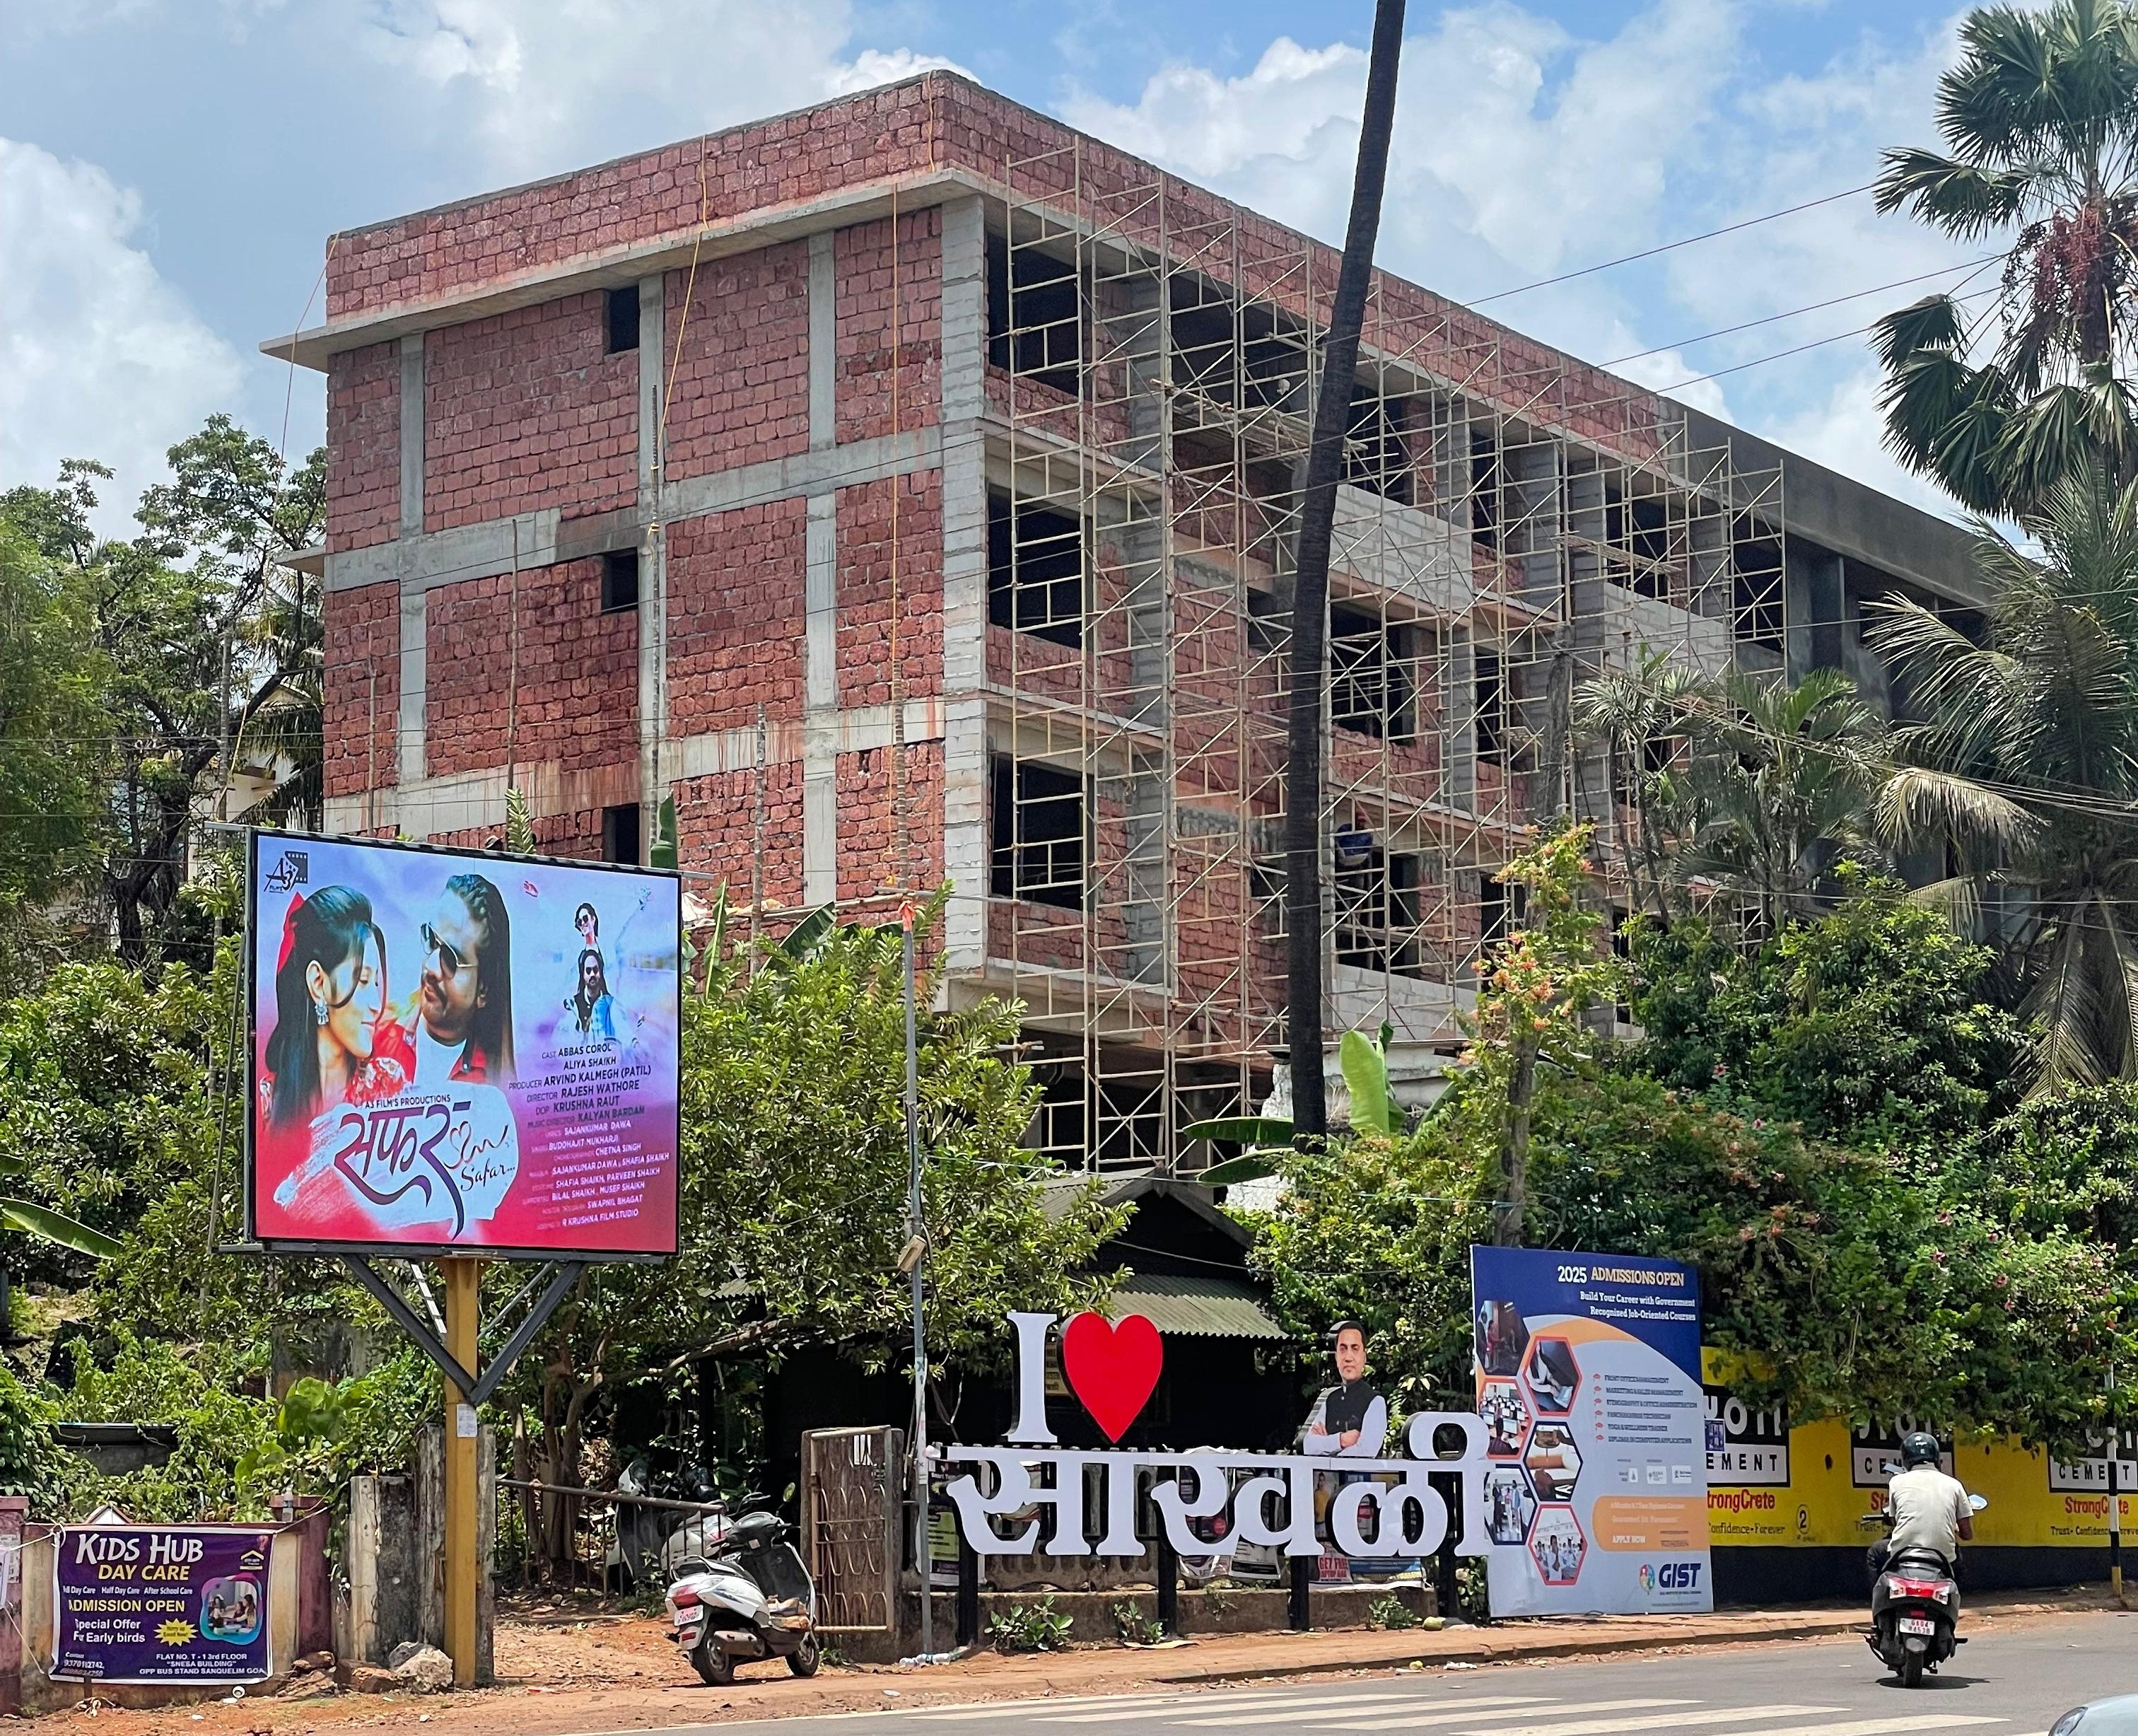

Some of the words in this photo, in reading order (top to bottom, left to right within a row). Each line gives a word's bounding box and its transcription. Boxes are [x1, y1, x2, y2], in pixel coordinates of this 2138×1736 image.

[542, 1051, 556, 1059] CAST
[558, 1046, 584, 1056] ABBAS
[586, 1043, 612, 1054] COROL
[563, 1059, 586, 1070] ALIYA
[588, 1056, 617, 1067] SHAIKH
[509, 1080, 542, 1090] PRODUCER
[543, 1073, 576, 1087] ARVIND
[578, 1068, 619, 1082] KALMEGH
[621, 1065, 651, 1078] (PATIL)
[527, 1092, 558, 1102] DIRECTOR
[561, 1085, 594, 1098] RAJESH
[596, 1080, 640, 1095] WATHORE
[400, 1095, 451, 1106] PRODUCTIONS
[536, 1106, 550, 1115] DOP
[553, 1100, 595, 1113] KRUSHNA
[597, 1095, 620, 1107] RAUT
[578, 1109, 610, 1122] KALYAN
[564, 1123, 608, 1136] SAJANKUMAR
[610, 1119, 631, 1129] DAWA
[622, 1143, 641, 1153] SINGH
[552, 1162, 595, 1175] SAJANKUMAR
[646, 1153, 670, 1163] SHAIKH
[607, 1170, 636, 1182] PARVEEN
[637, 1167, 660, 1177] SHAIKH
[551, 1191, 570, 1201] BILAL
[621, 1181, 645, 1192] SHAIKH
[588, 1199, 616, 1209] SWAPNIL
[617, 1194, 643, 1205] BHAGAT
[568, 1213, 598, 1225] KRUSHNA
[600, 1211, 615, 1221] FILM
[616, 1208, 639, 1218] STUDIO
[1558, 1266, 1587, 1283] 2025
[1591, 1266, 1656, 1286] ADMISSIONS
[1656, 1272, 1684, 1286] OPEN
[1580, 1291, 1599, 1301] Build
[1599, 1292, 1616, 1303] Your
[1616, 1293, 1638, 1304] Career
[1640, 1295, 1654, 1305] with
[1655, 1297, 1695, 1307] Government
[1628, 1309, 1669, 1320] Job-Oriented
[1670, 1312, 1696, 1321] Courses
[1007, 1312, 1058, 1443] I
[1705, 1452, 1777, 1471] EMENT
[2059, 1464, 2130, 1481] CEMET
[1707, 1489, 1775, 1513] trongCrete
[2065, 1496, 2129, 1519] StrongCte
[1799, 1510, 1807, 1529] 2
[98, 1564, 138, 1580] DAY
[141, 1565, 191, 1580] CARE
[1659, 1563, 1701, 1588] GIST
[71, 1586, 82, 1595] Day
[115, 1587, 126, 1596] Day
[146, 1600, 185, 1612] OPEN
[113, 1619, 141, 1629] Offer
[86, 1632, 114, 1645] Early
[117, 1632, 146, 1643] birds
